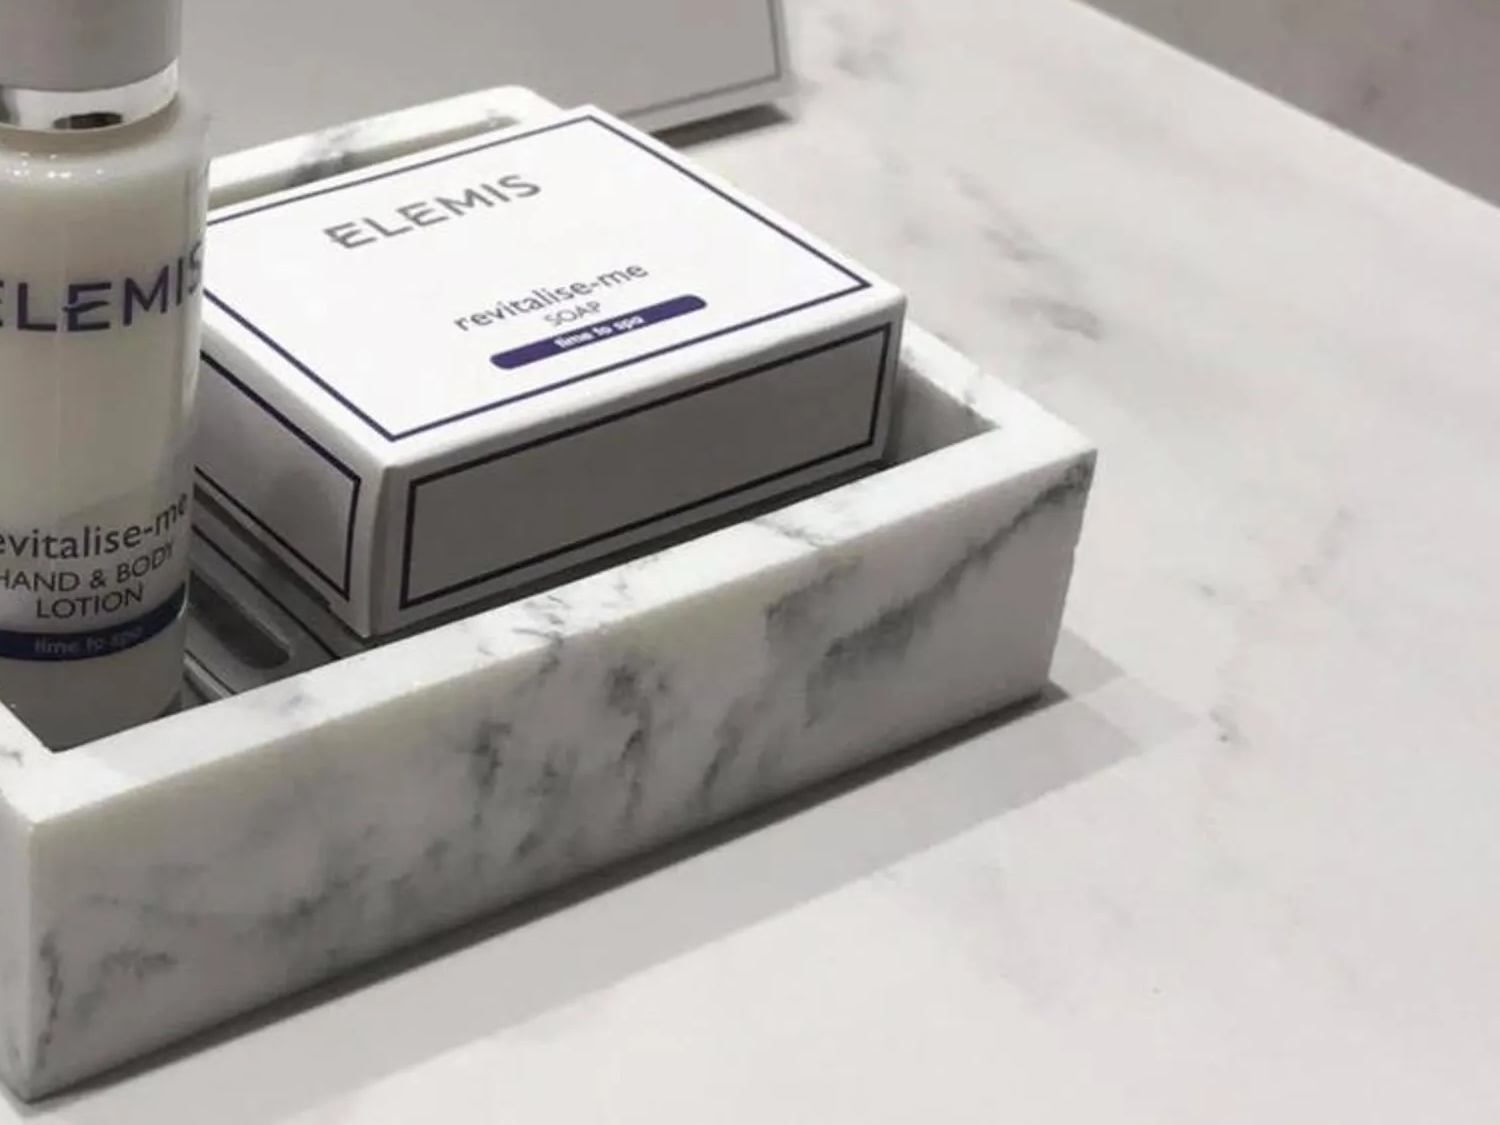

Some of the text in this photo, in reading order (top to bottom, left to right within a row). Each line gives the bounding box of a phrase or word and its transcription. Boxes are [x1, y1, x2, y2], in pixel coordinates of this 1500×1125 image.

[323, 174, 541, 249] ELEMIS
[454, 264, 649, 332] revitalise-me
[544, 301, 601, 327] SOAP
[592, 325, 613, 337] to
[90, 569, 107, 590] &
[116, 538, 175, 584] BODY
[36, 584, 144, 620] LOTION
